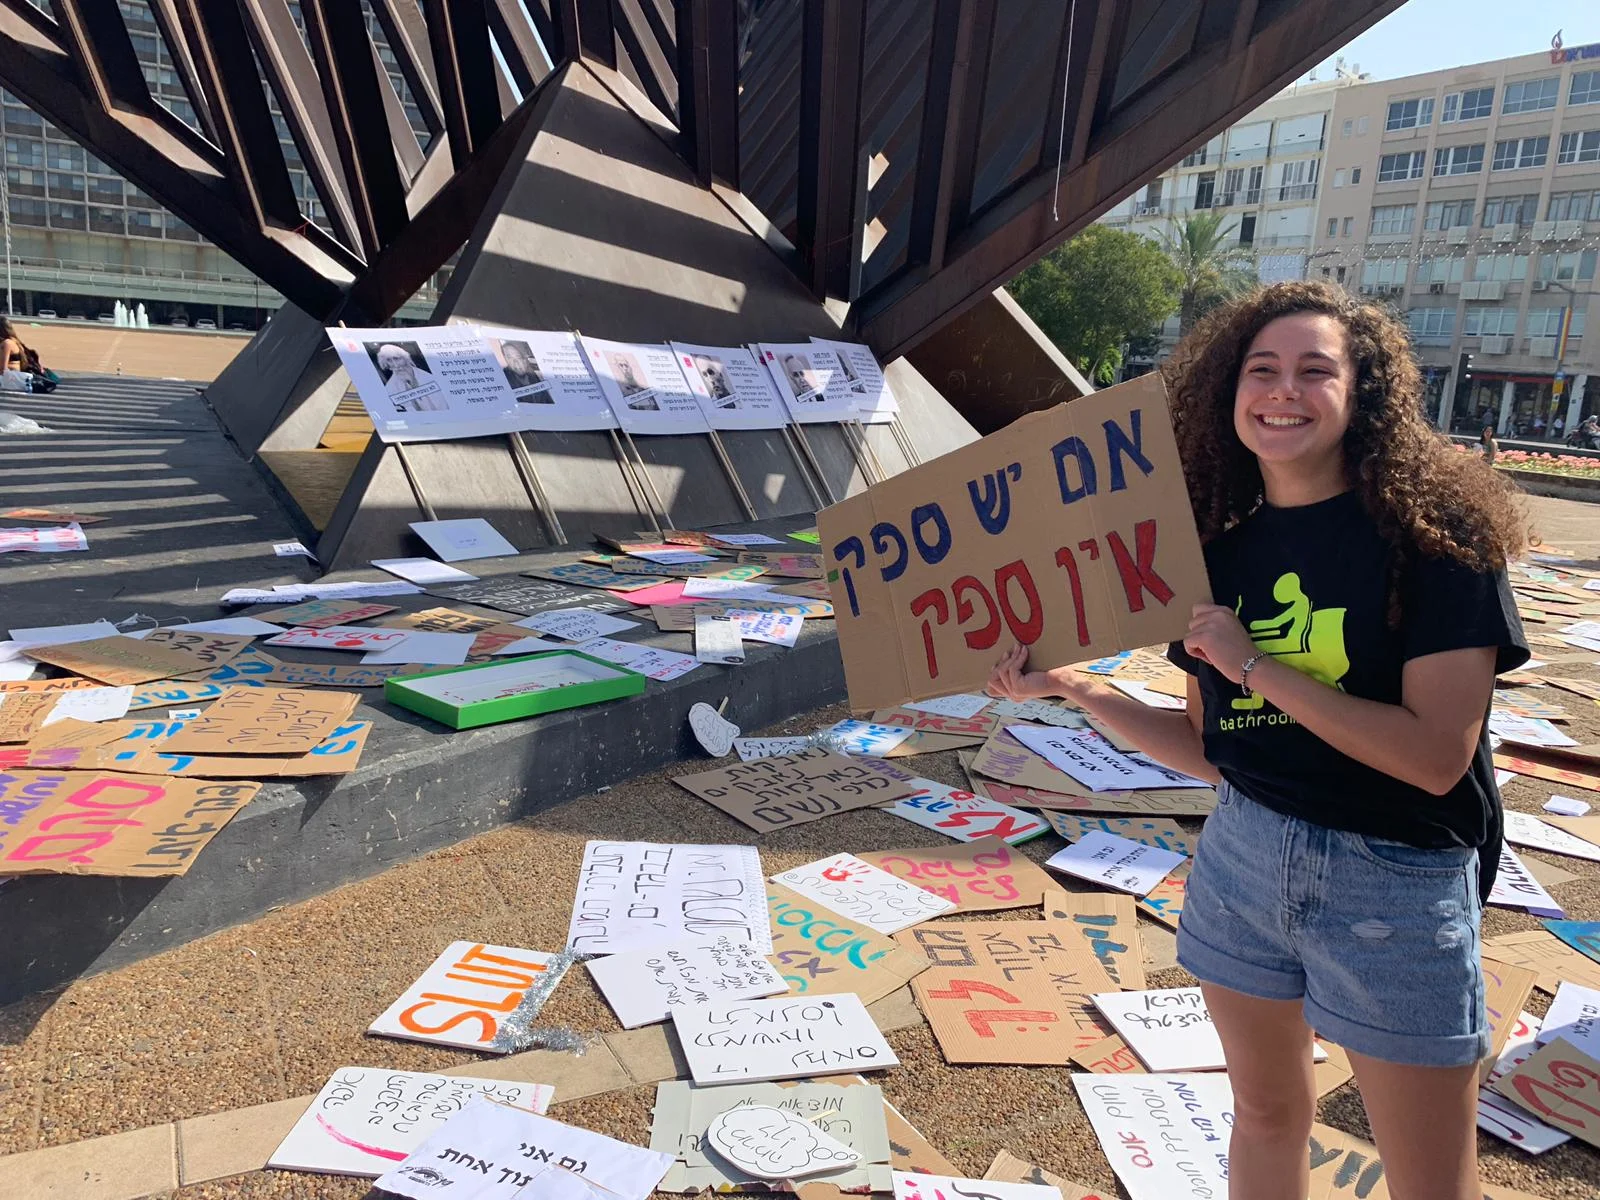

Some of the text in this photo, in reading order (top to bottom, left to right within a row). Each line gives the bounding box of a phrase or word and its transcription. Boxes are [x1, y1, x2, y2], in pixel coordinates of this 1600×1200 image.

[832, 409, 1155, 618] אם יש ספק
[910, 518, 1176, 679] אין ספק
[725, 747, 830, 782] נאבקות
[704, 768, 805, 798] נאבקים
[754, 766, 872, 805] באלימות
[833, 777, 890, 796] כלפי
[751, 794, 843, 825] נשים
[935, 810, 1039, 840] לא
[687, 853, 726, 876] אני
[912, 928, 979, 967] גם
[977, 931, 1035, 982] אסור
[1027, 933, 1065, 963] בלי
[398, 943, 549, 1043] SLUT
[694, 1028, 815, 1047] תאשימו
[791, 1046, 878, 1068] נמאס
[323, 1072, 366, 1111] איפה
[1092, 1084, 1134, 1119] היום
[1117, 1130, 1154, 1169] אנס
[1133, 1086, 1190, 1153] מסתובב
[1166, 1080, 1203, 1113] מחר
[1190, 1117, 1222, 1143] הוא
[436, 1146, 495, 1174] אחת
[517, 1141, 589, 1173] גם אני
